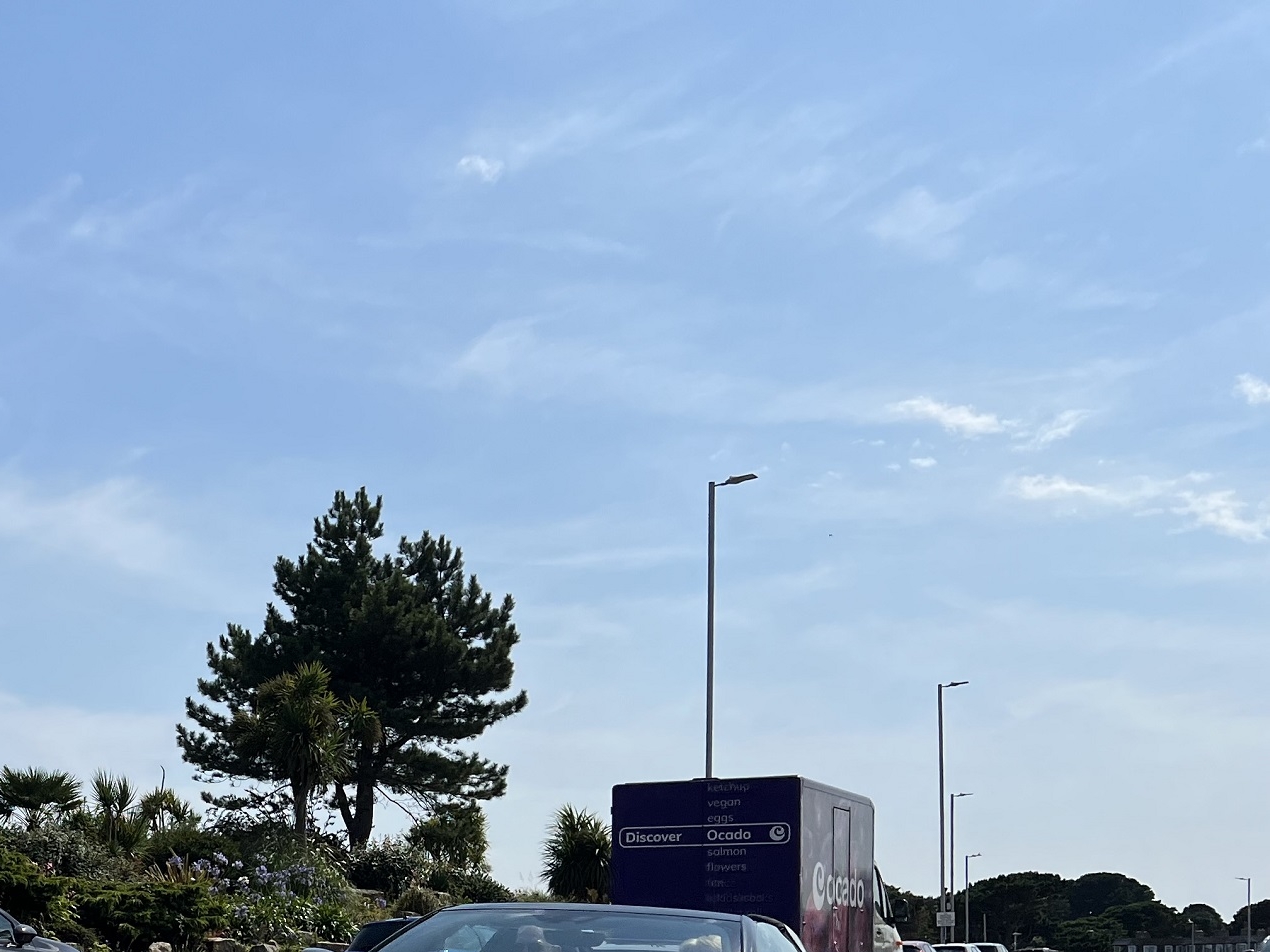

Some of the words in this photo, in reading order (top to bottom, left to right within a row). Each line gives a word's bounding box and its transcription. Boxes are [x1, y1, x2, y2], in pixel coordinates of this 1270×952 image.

[707, 782, 750, 793] ketchup
[707, 798, 741, 810] vegan
[707, 813, 734, 825] eggs
[626, 831, 683, 843] Discover
[706, 829, 751, 841] Ocado
[707, 846, 747, 857] salmon
[706, 861, 747, 872] flowers
